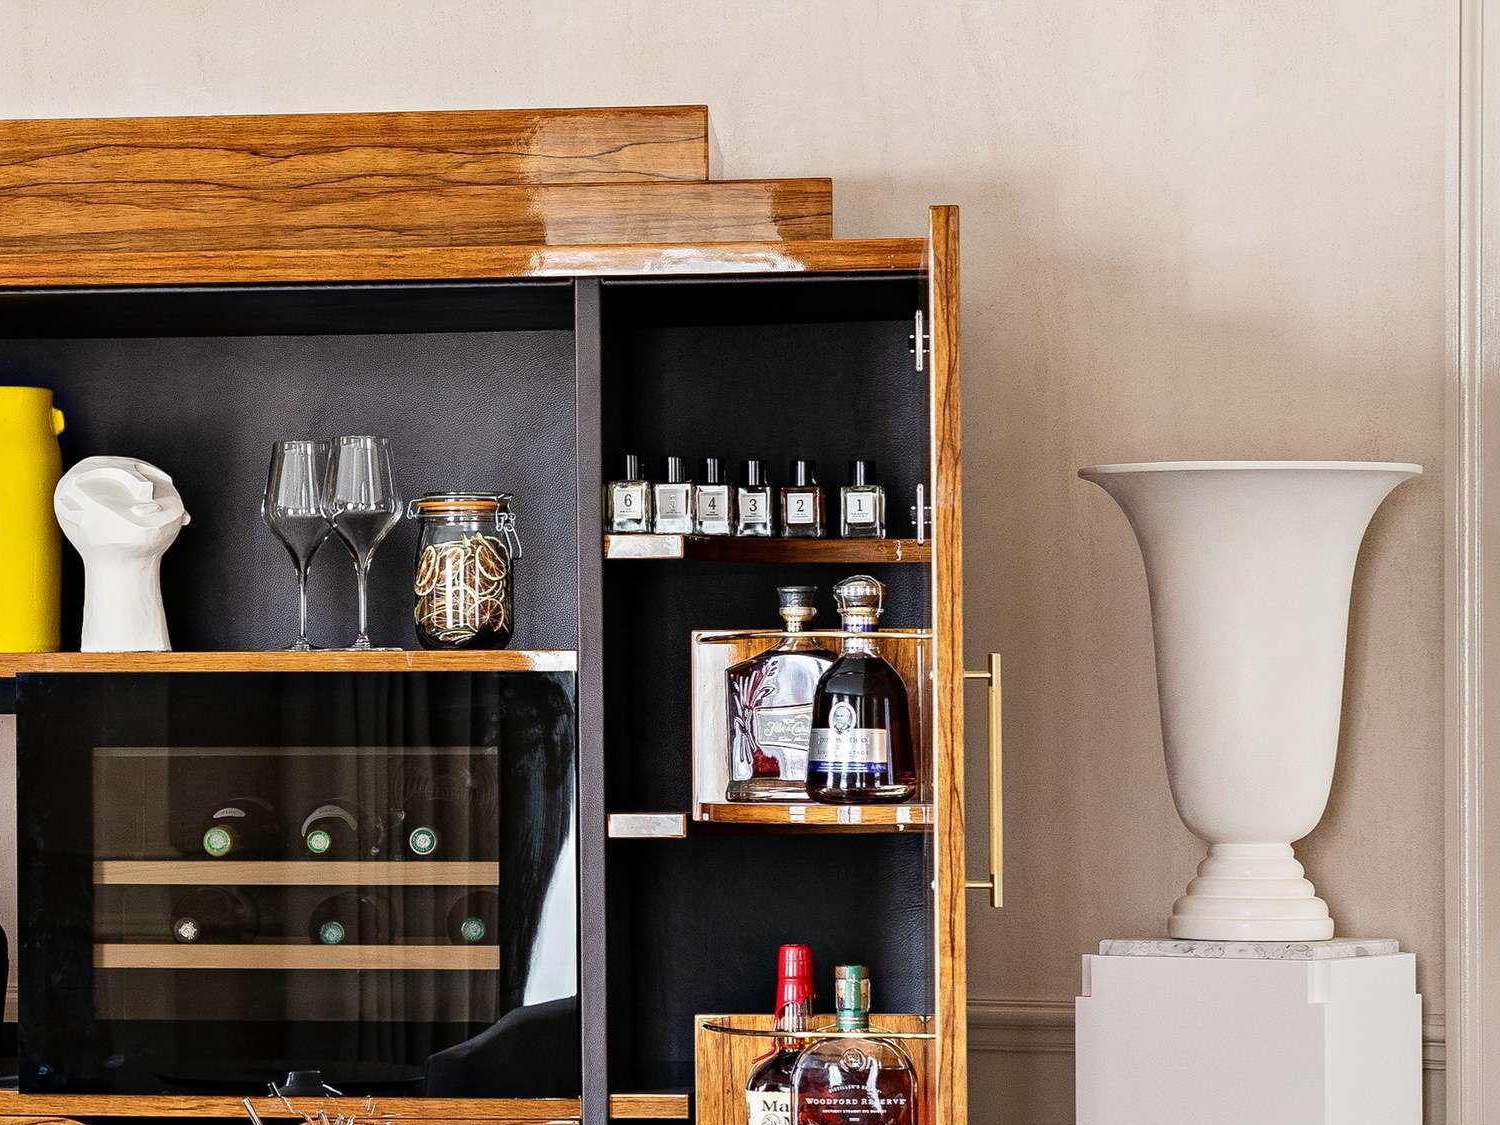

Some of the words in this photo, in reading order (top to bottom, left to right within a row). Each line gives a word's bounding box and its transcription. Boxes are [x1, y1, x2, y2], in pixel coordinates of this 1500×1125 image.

[624, 493, 633, 508] 6
[707, 496, 717, 510] 4
[748, 498, 758, 512] 3
[796, 499, 805, 512] 2
[856, 499, 863, 512] 1
